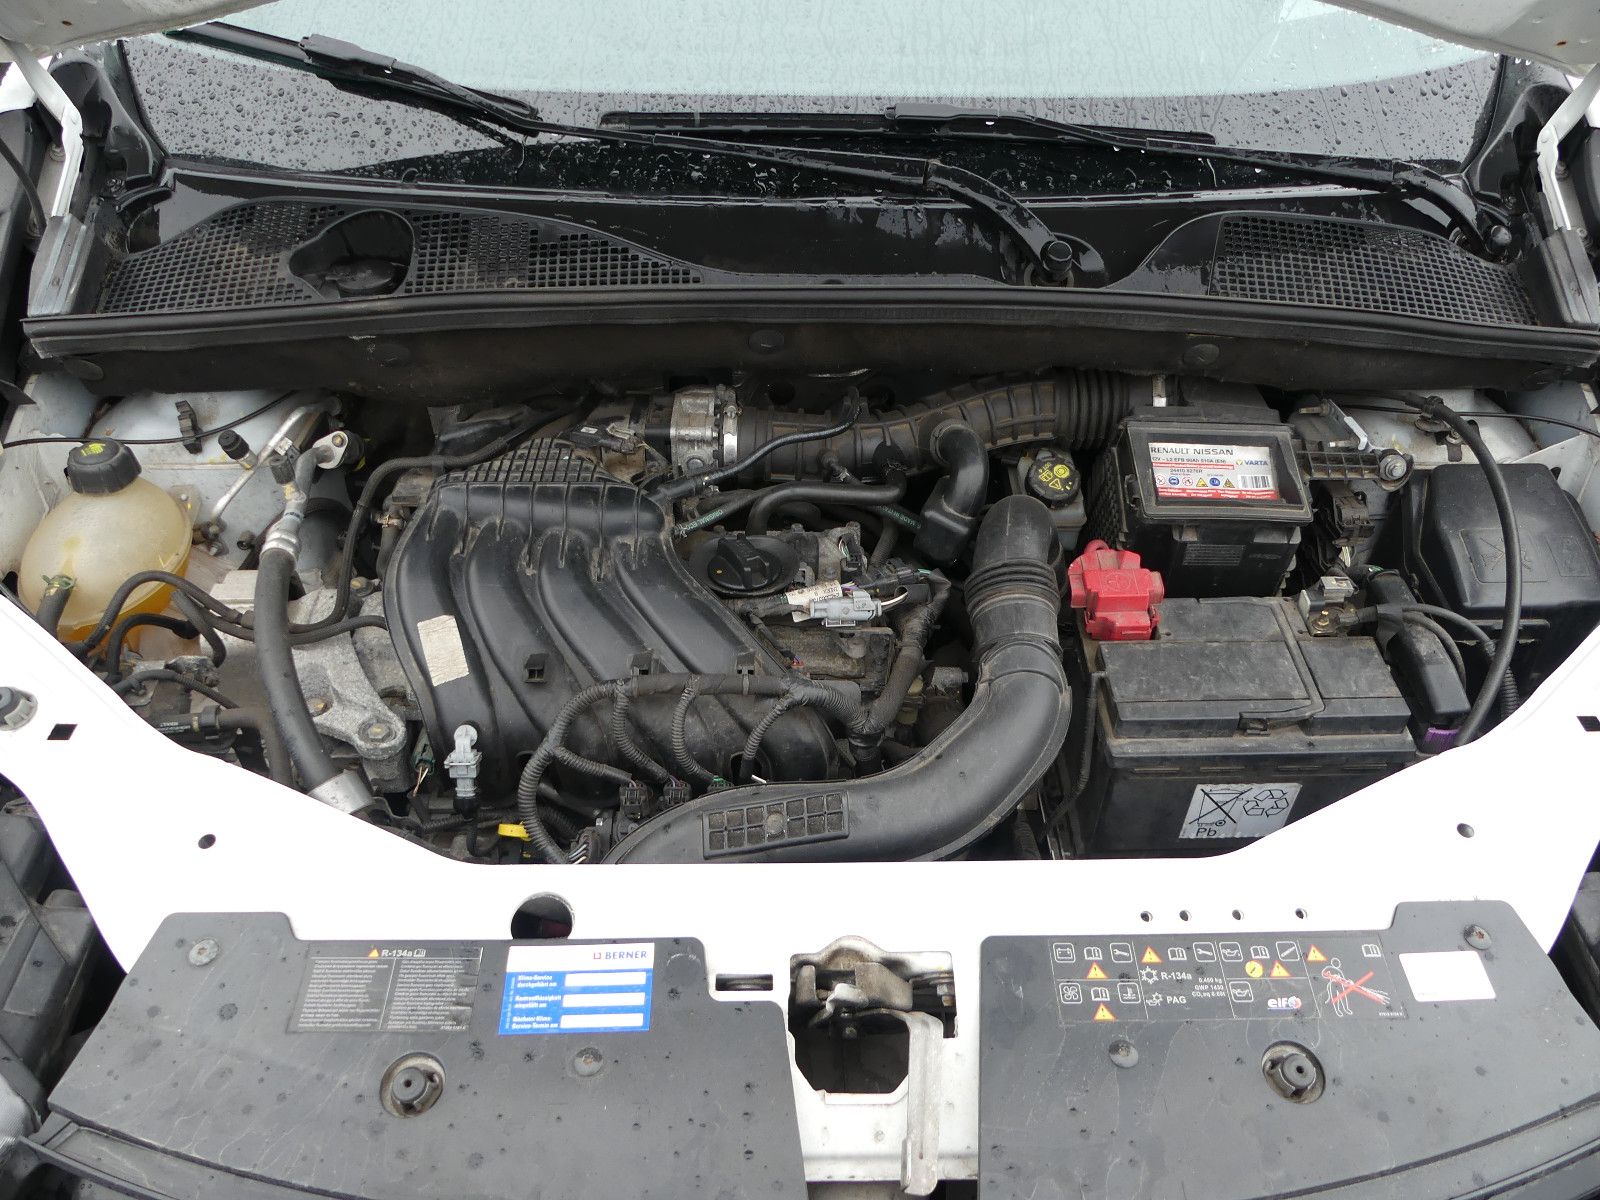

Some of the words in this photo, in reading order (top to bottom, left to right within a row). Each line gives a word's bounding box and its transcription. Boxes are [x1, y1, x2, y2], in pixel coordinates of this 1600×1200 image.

[1193, 448, 1234, 456] NISSAN
[1196, 828, 1216, 836] Pb
[382, 949, 412, 957] R-134a
[605, 951, 647, 960] BERNER
[1161, 972, 1192, 980] R-134a
[1167, 996, 1187, 1004] PAG
[1267, 998, 1288, 1008] elf
